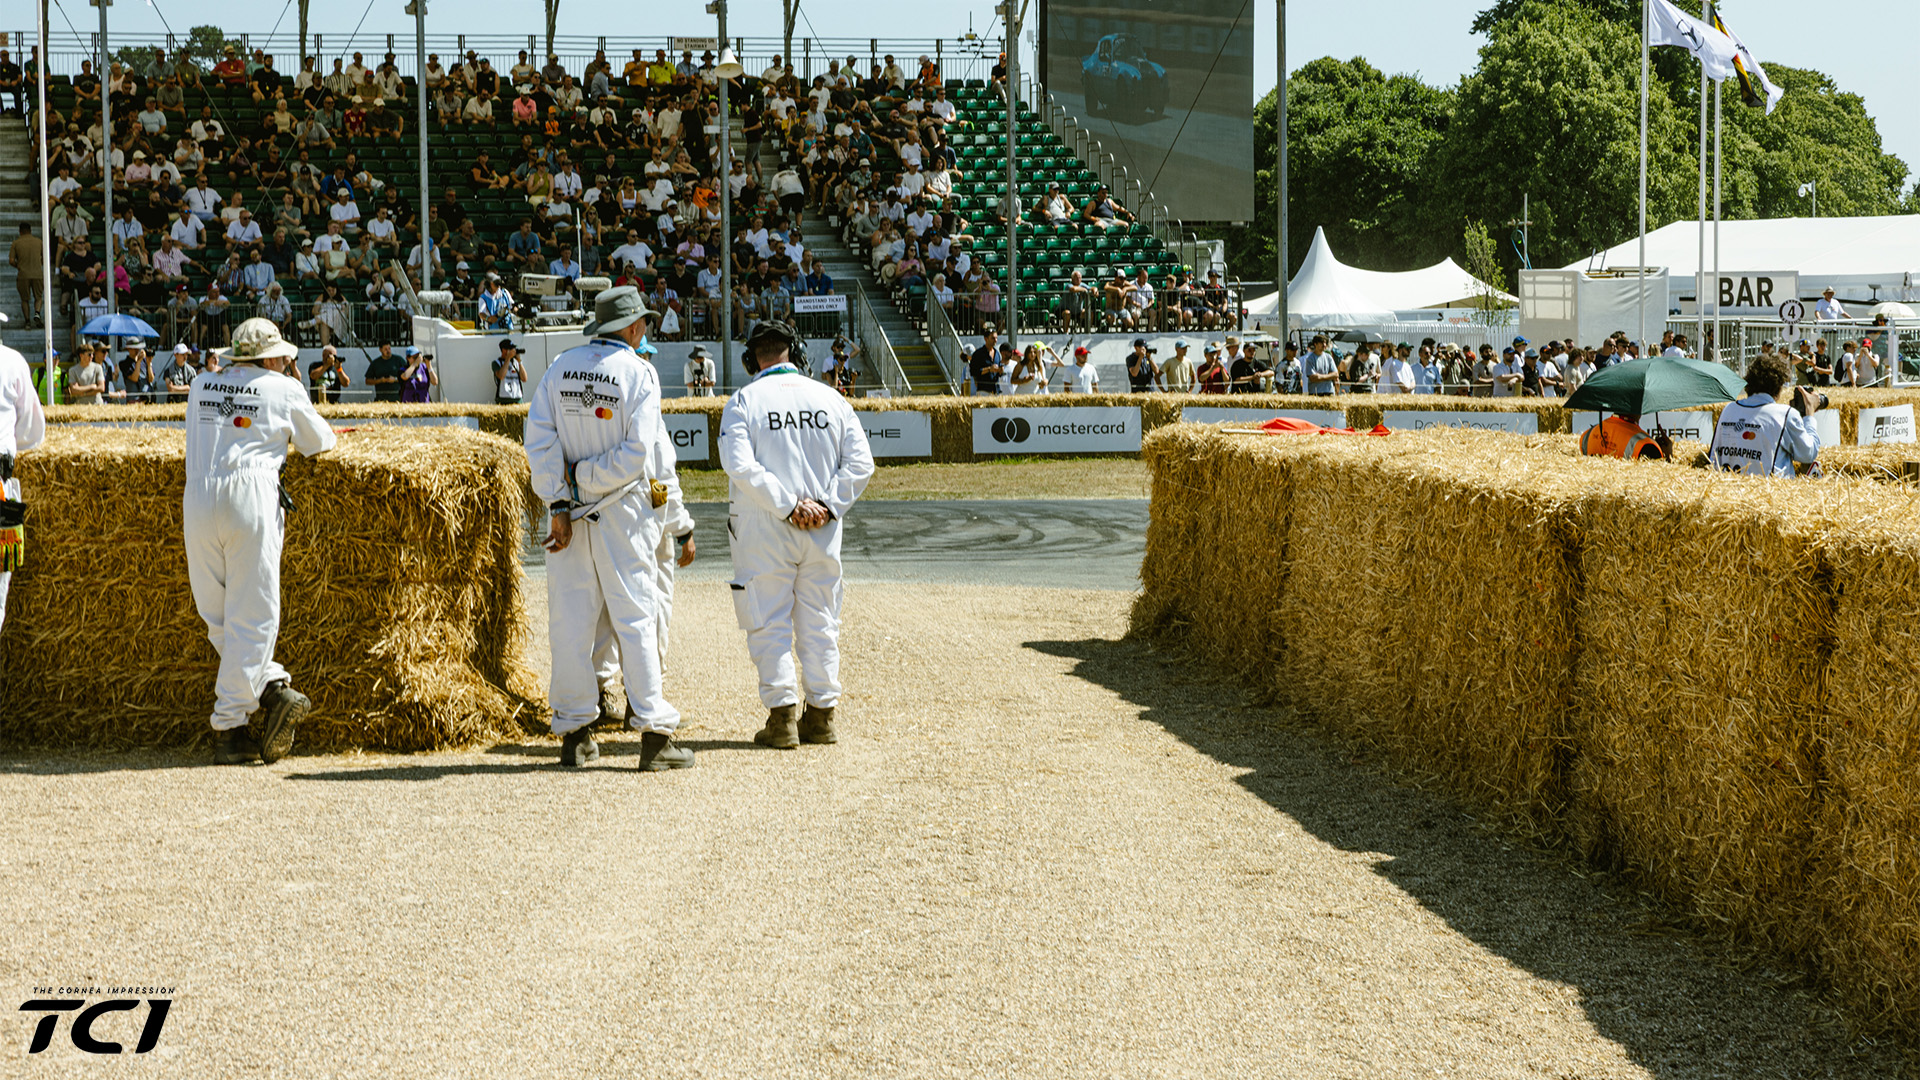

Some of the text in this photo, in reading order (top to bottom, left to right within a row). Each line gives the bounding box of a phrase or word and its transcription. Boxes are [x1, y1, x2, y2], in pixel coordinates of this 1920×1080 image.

[1719, 277, 1774, 307] BAR
[1787, 305, 1796, 320] 4
[562, 371, 619, 387] MARSHAL
[203, 382, 261, 397] MARSHAL
[768, 410, 829, 430] BARC
[1037, 422, 1125, 435] mastercard
